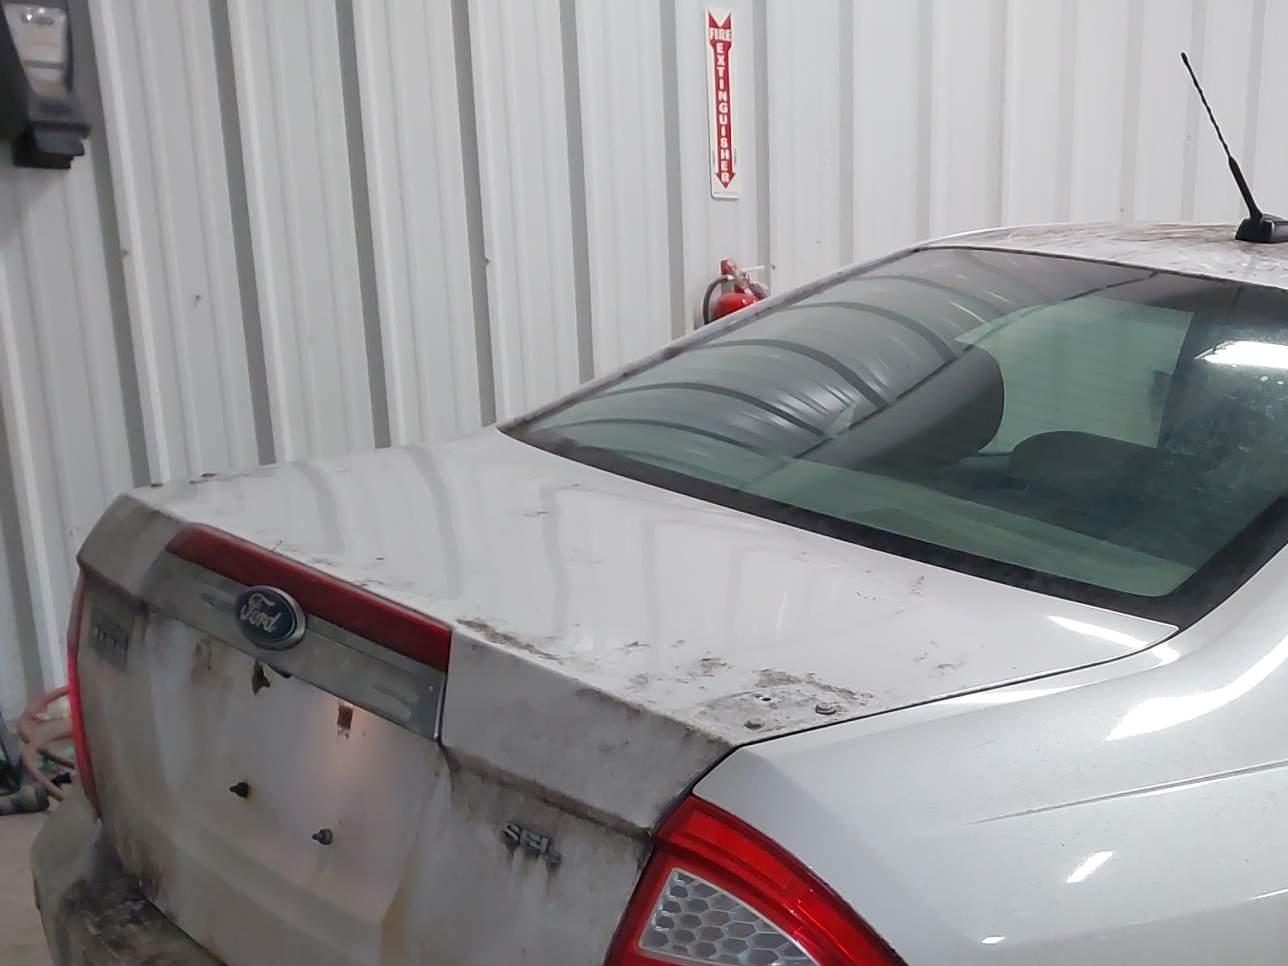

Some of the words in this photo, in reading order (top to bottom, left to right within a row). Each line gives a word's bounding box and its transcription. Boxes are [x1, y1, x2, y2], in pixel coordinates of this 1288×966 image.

[709, 27, 732, 41] FIRE
[716, 42, 730, 183] EXTINGUISHER
[240, 592, 282, 633] Ford
